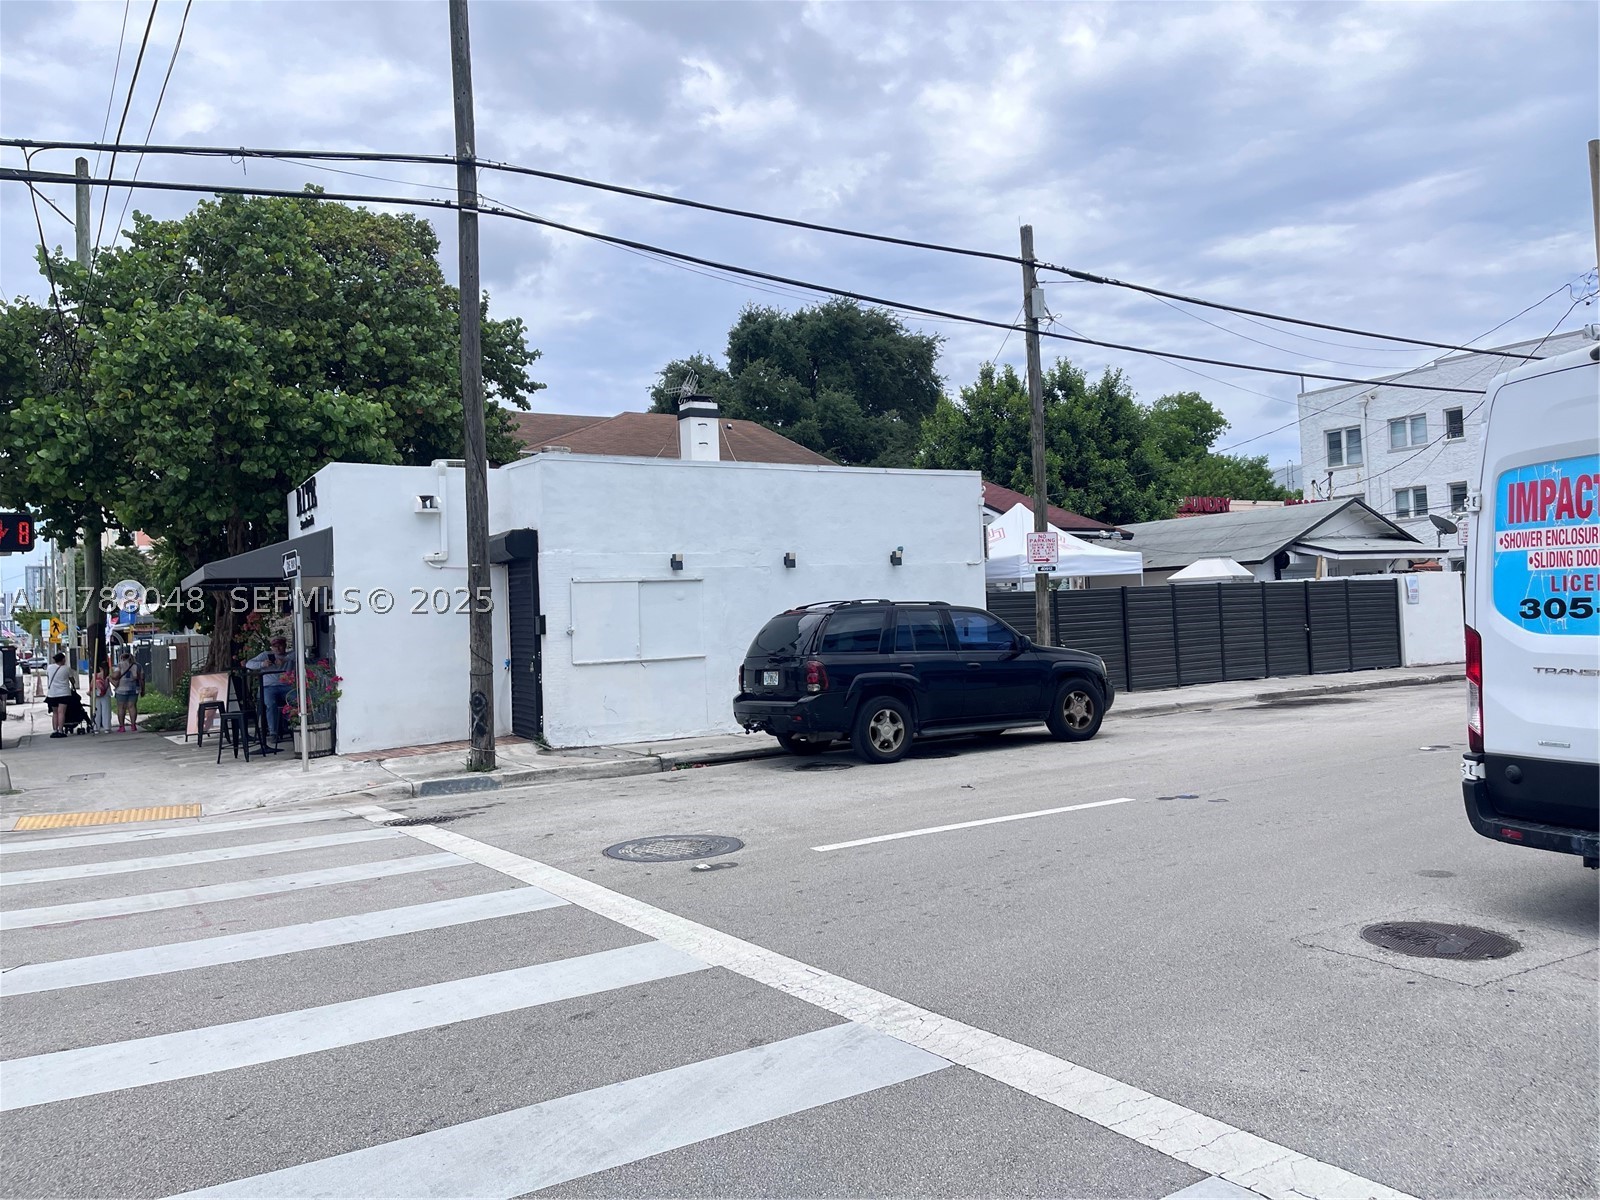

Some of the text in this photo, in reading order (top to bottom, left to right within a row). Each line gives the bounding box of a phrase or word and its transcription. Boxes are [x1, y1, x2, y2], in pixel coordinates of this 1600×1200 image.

[18, 521, 30, 545] 8
[1503, 531, 1543, 550] SHOWER
[1533, 549, 1600, 569] SLIDING DOO
[1551, 574, 1600, 592] LICE
